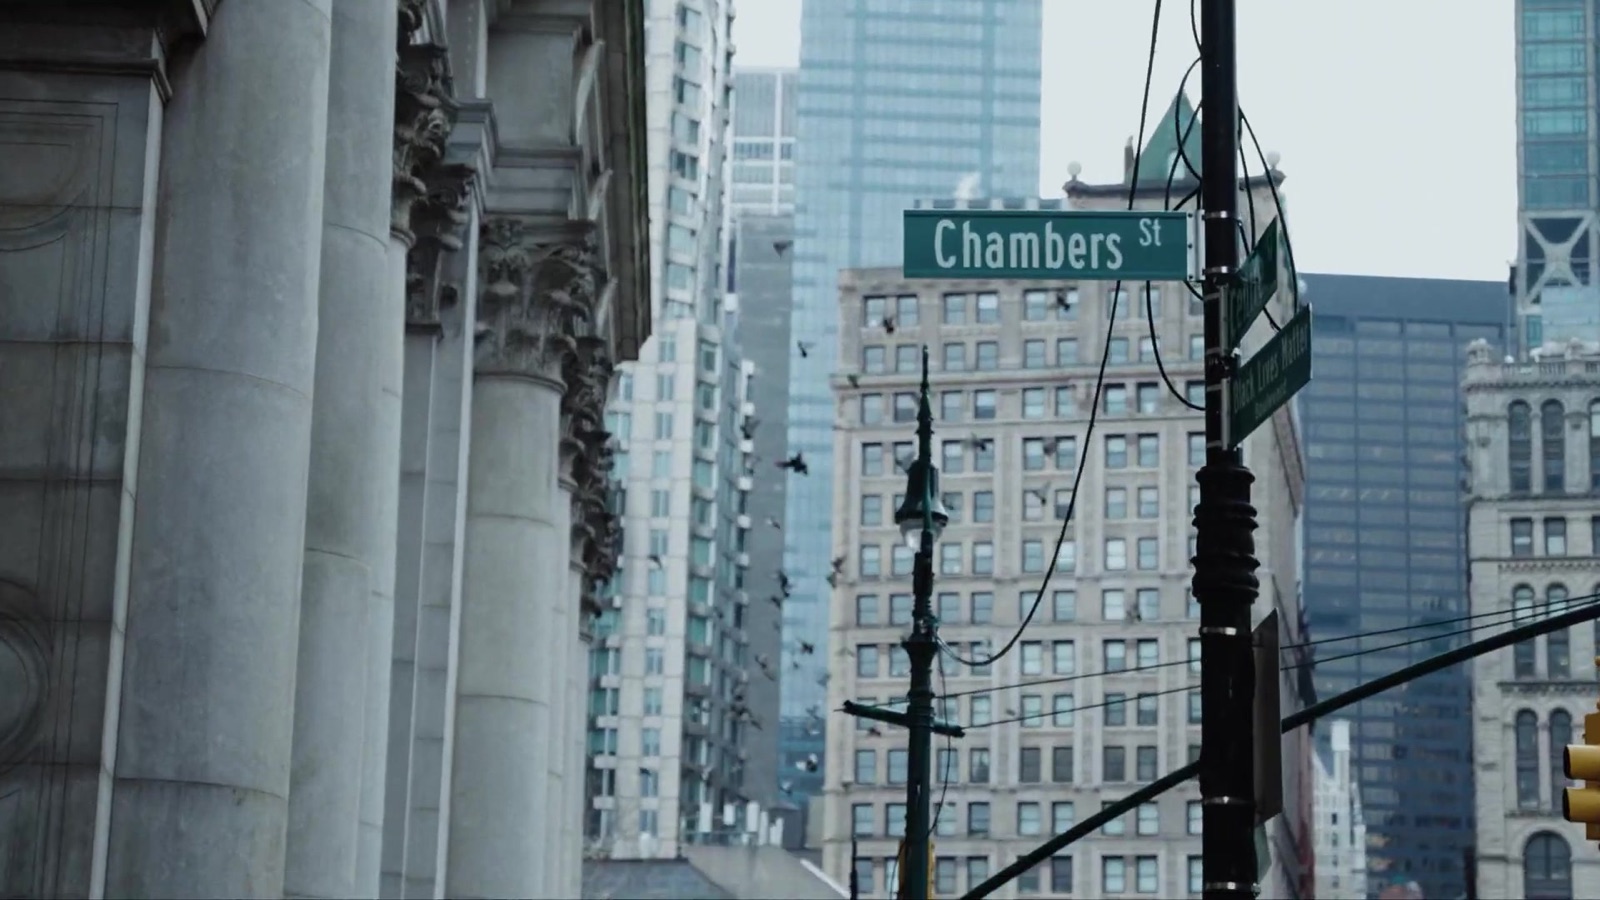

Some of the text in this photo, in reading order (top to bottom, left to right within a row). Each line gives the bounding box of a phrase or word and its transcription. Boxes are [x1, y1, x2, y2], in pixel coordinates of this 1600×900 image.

[934, 218, 1162, 269] Chambers St
[1233, 324, 1309, 413] Black Lives Matter
